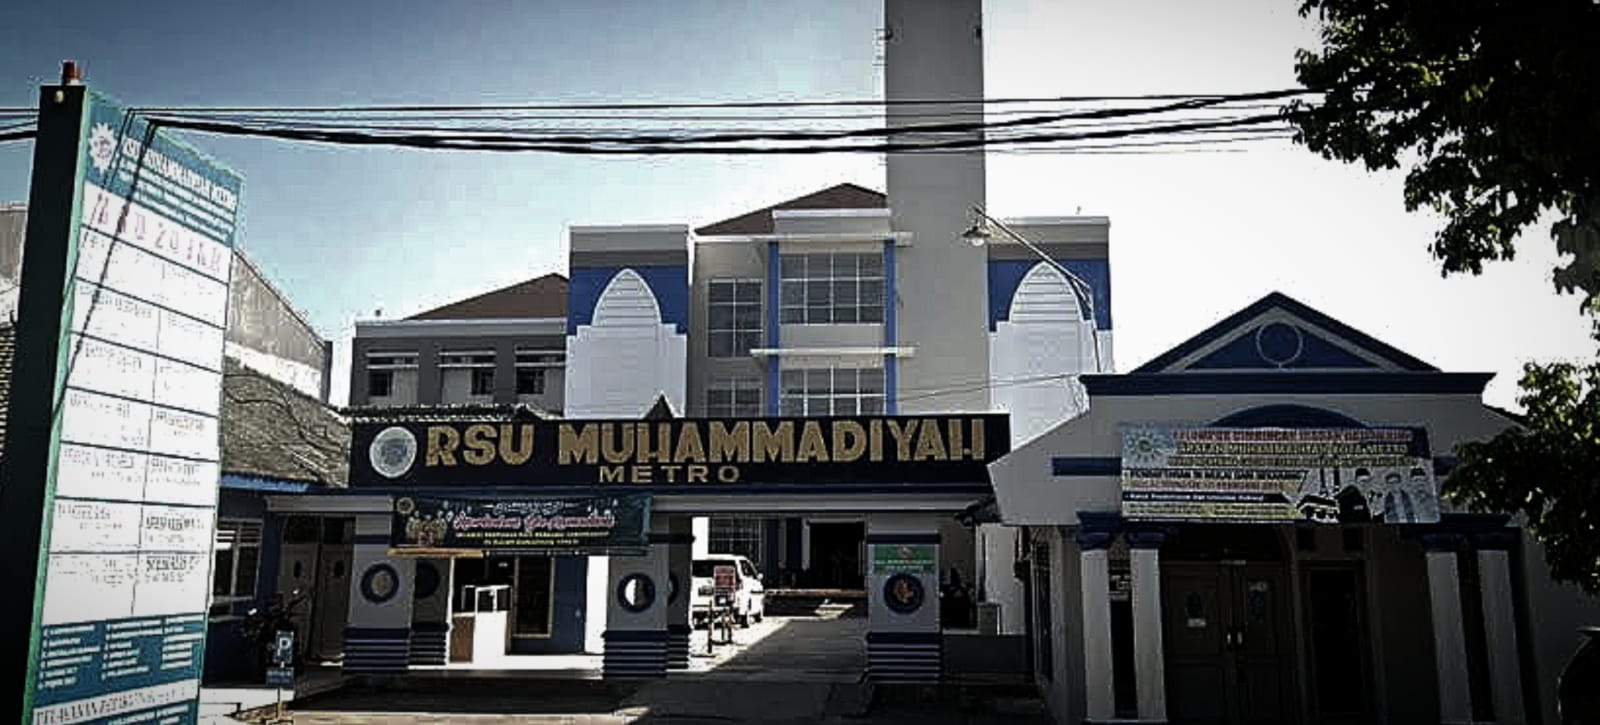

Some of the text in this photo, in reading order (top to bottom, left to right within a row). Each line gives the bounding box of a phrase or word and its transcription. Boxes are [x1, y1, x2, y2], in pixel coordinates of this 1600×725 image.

[425, 419, 986, 467] RSU MUHAMMADIYAH
[599, 465, 741, 484] METRO
